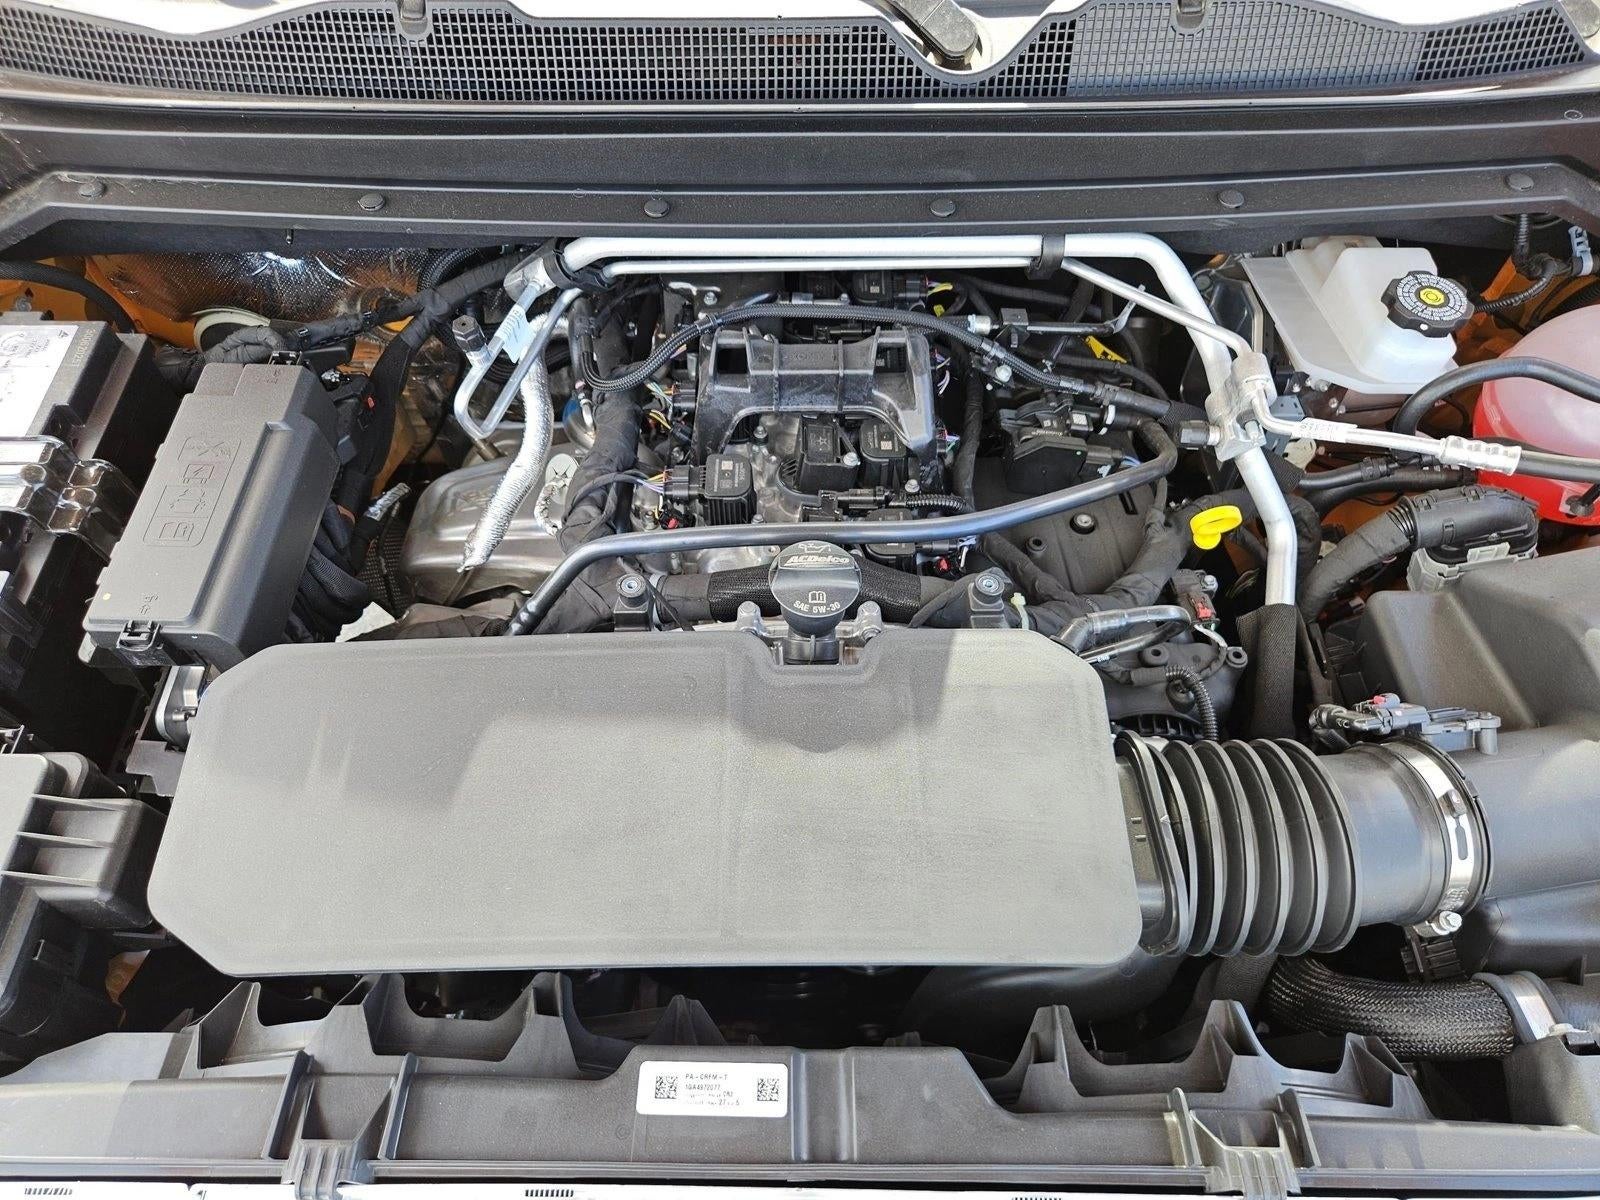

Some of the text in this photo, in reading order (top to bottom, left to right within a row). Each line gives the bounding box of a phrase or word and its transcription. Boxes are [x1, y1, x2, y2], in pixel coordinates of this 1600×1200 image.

[785, 555, 850, 564] ACDelco
[793, 600, 841, 613] SAE 5W-30
